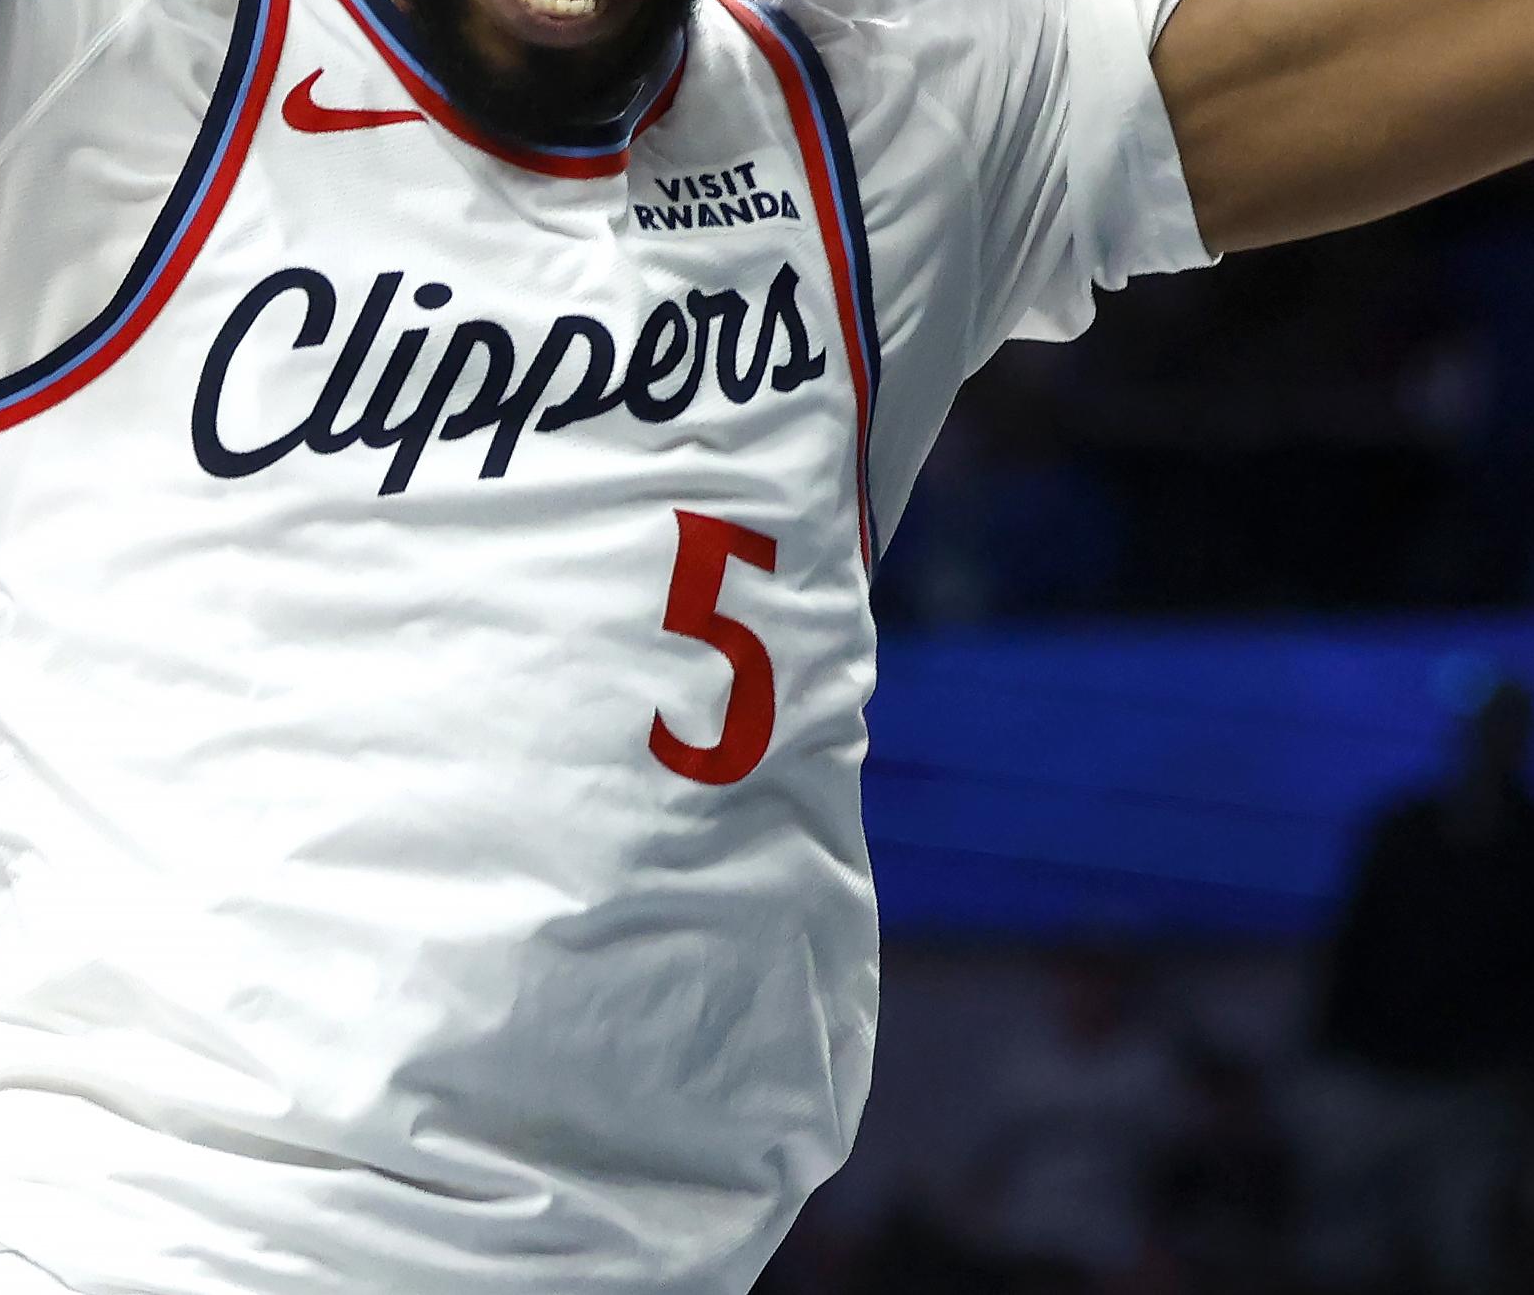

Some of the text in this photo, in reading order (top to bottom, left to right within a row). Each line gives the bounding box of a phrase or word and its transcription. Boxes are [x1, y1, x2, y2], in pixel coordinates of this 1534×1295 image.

[633, 190, 801, 231] RWANDA
[654, 161, 757, 202] VISIT
[191, 262, 826, 495] Clippers
[648, 508, 777, 786] 5
